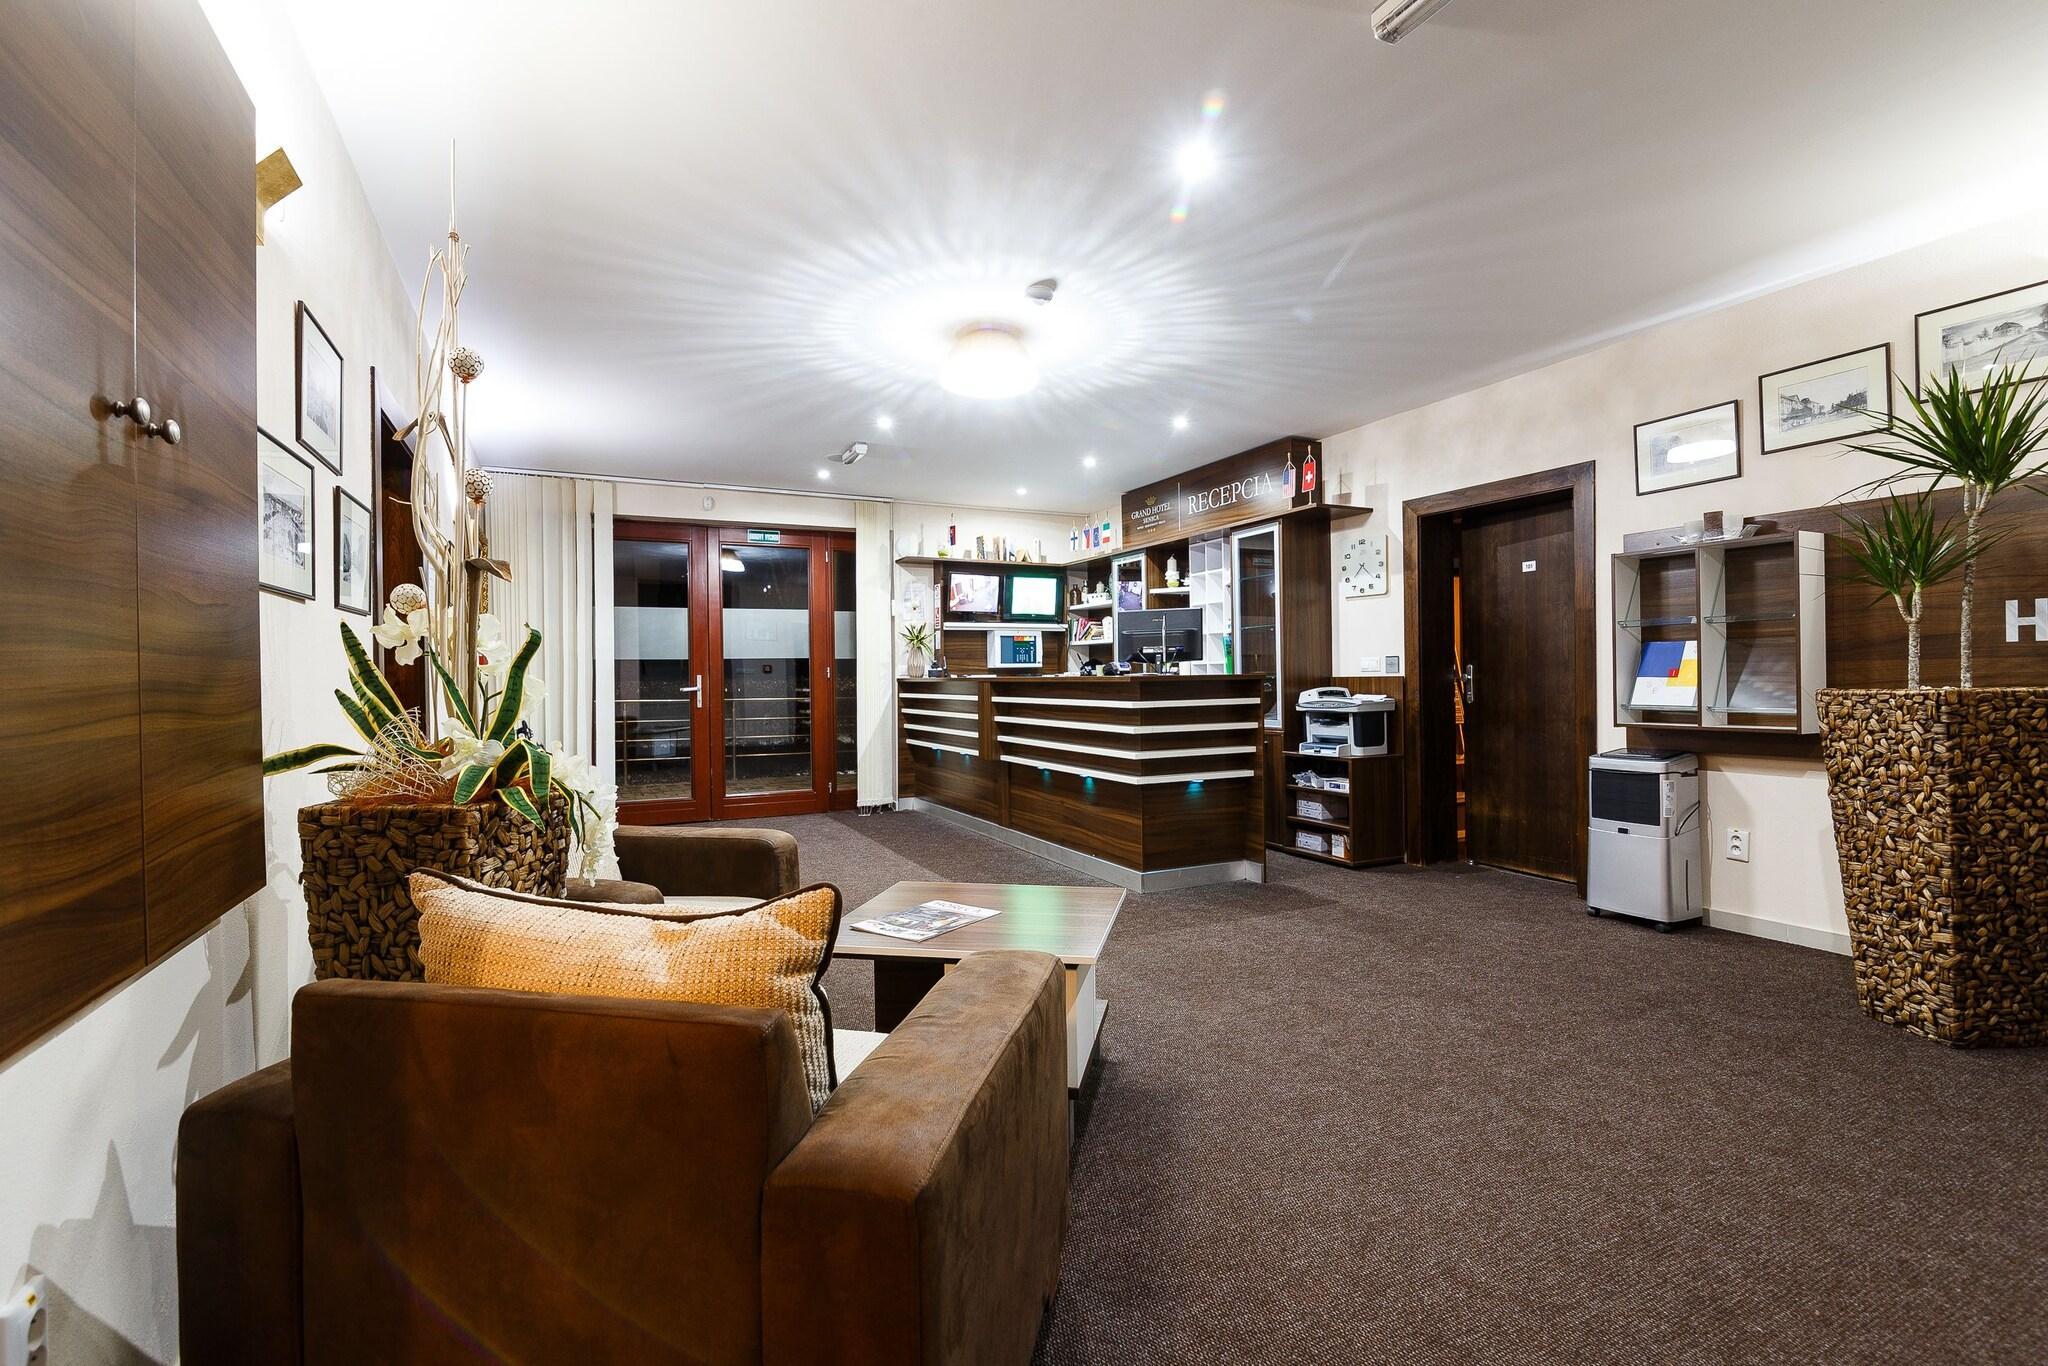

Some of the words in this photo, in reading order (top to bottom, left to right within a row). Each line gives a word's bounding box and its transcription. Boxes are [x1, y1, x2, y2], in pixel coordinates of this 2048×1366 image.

[1131, 507, 1151, 520] GRAND
[1152, 502, 1170, 515] HOTEL
[1187, 472, 1273, 515] RECEPCIA
[2005, 598, 2048, 642] H
